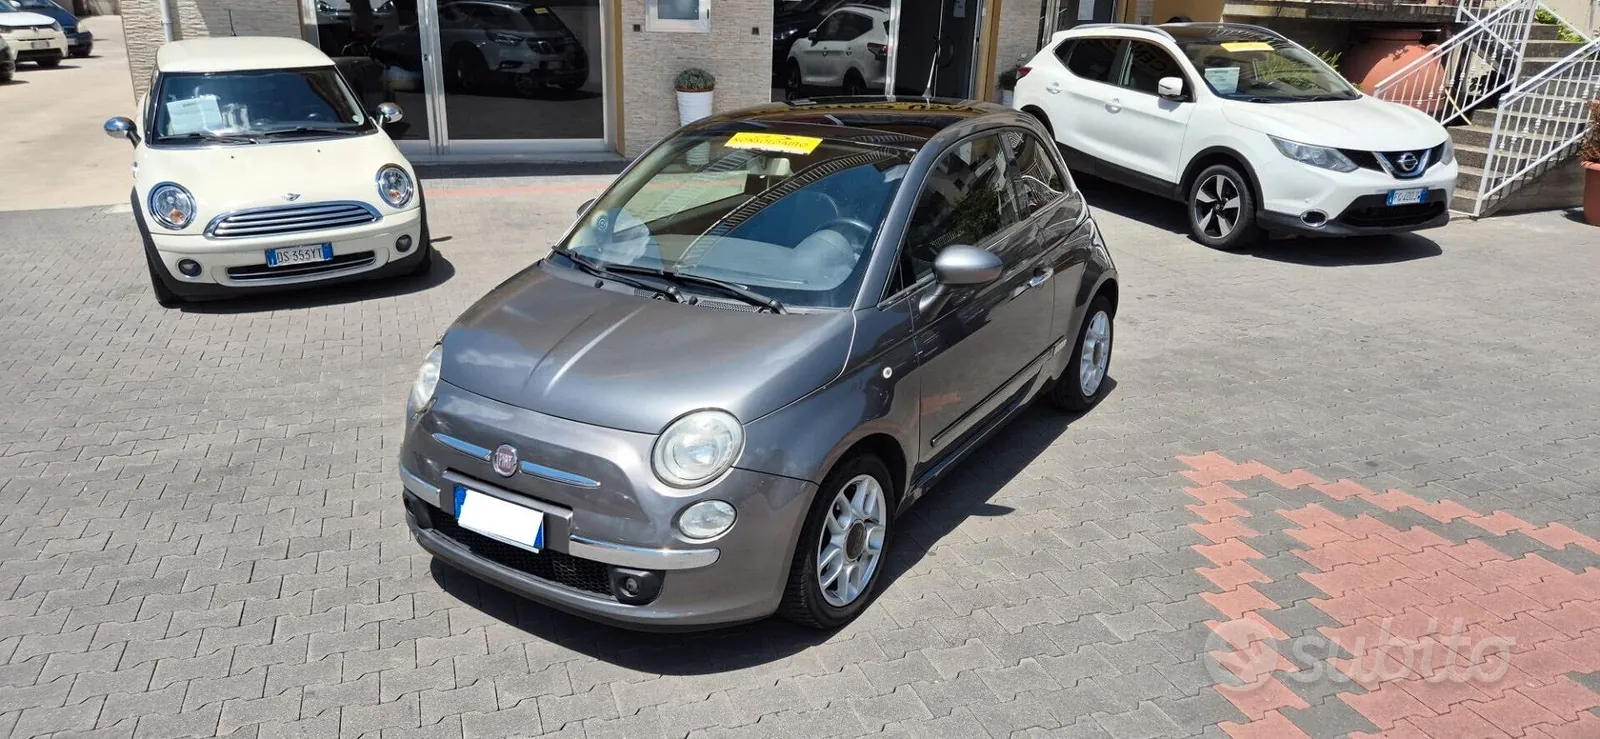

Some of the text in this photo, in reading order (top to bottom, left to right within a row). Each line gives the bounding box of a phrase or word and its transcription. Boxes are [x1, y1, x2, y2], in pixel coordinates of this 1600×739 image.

[276, 248, 322, 263] DS 353YT
[499, 453, 513, 469] FIAT
